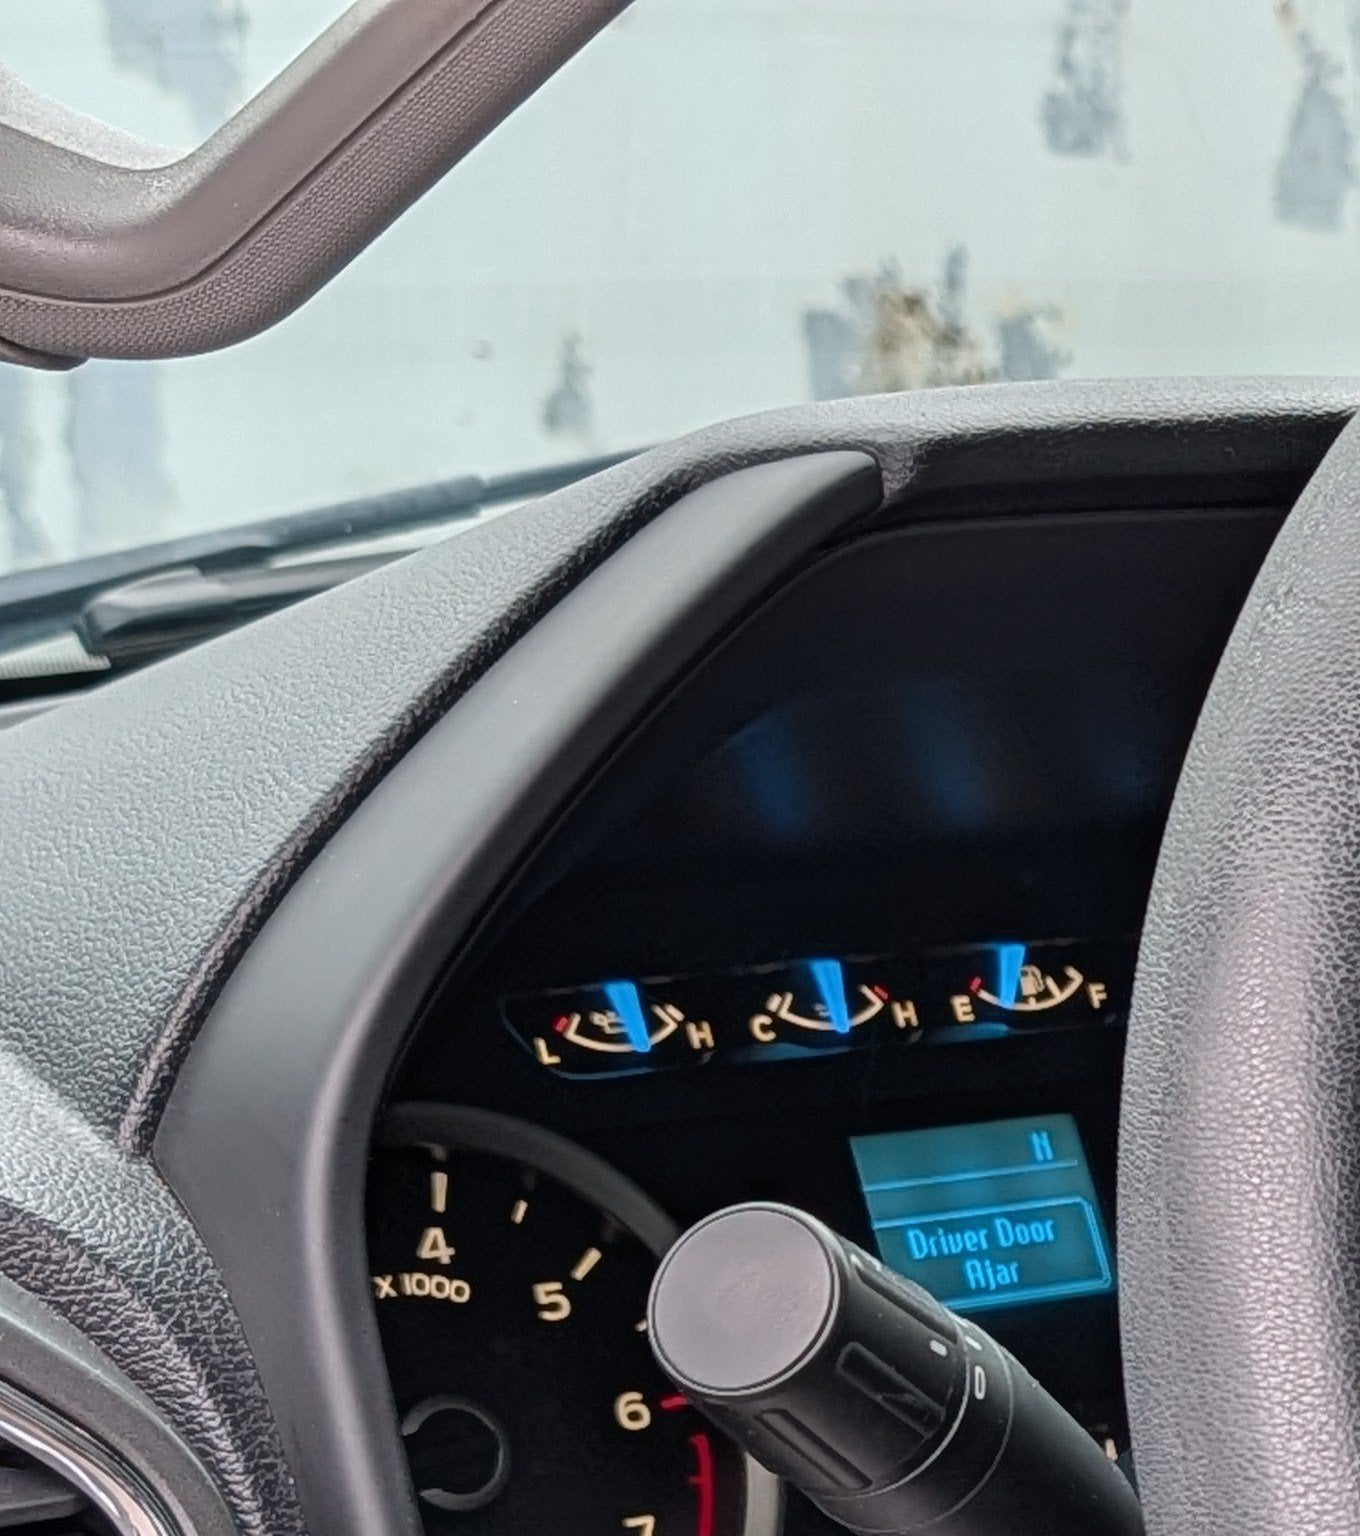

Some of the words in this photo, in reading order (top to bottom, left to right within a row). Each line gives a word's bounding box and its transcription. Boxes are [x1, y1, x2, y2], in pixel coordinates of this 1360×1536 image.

[950, 994, 974, 1022] E
[1087, 982, 1107, 1009] F
[750, 1015, 777, 1041] C
[890, 1001, 918, 1028] H
[686, 1021, 714, 1049] H
[533, 1037, 561, 1066] L
[416, 1226, 455, 1265] 4
[908, 1227, 988, 1259] Driver
[995, 1218, 1054, 1248] Door
[402, 1272, 471, 1303] 1000
[965, 1259, 1019, 1290] Ajar
[532, 1282, 571, 1321] 5
[614, 1391, 651, 1431] 6
